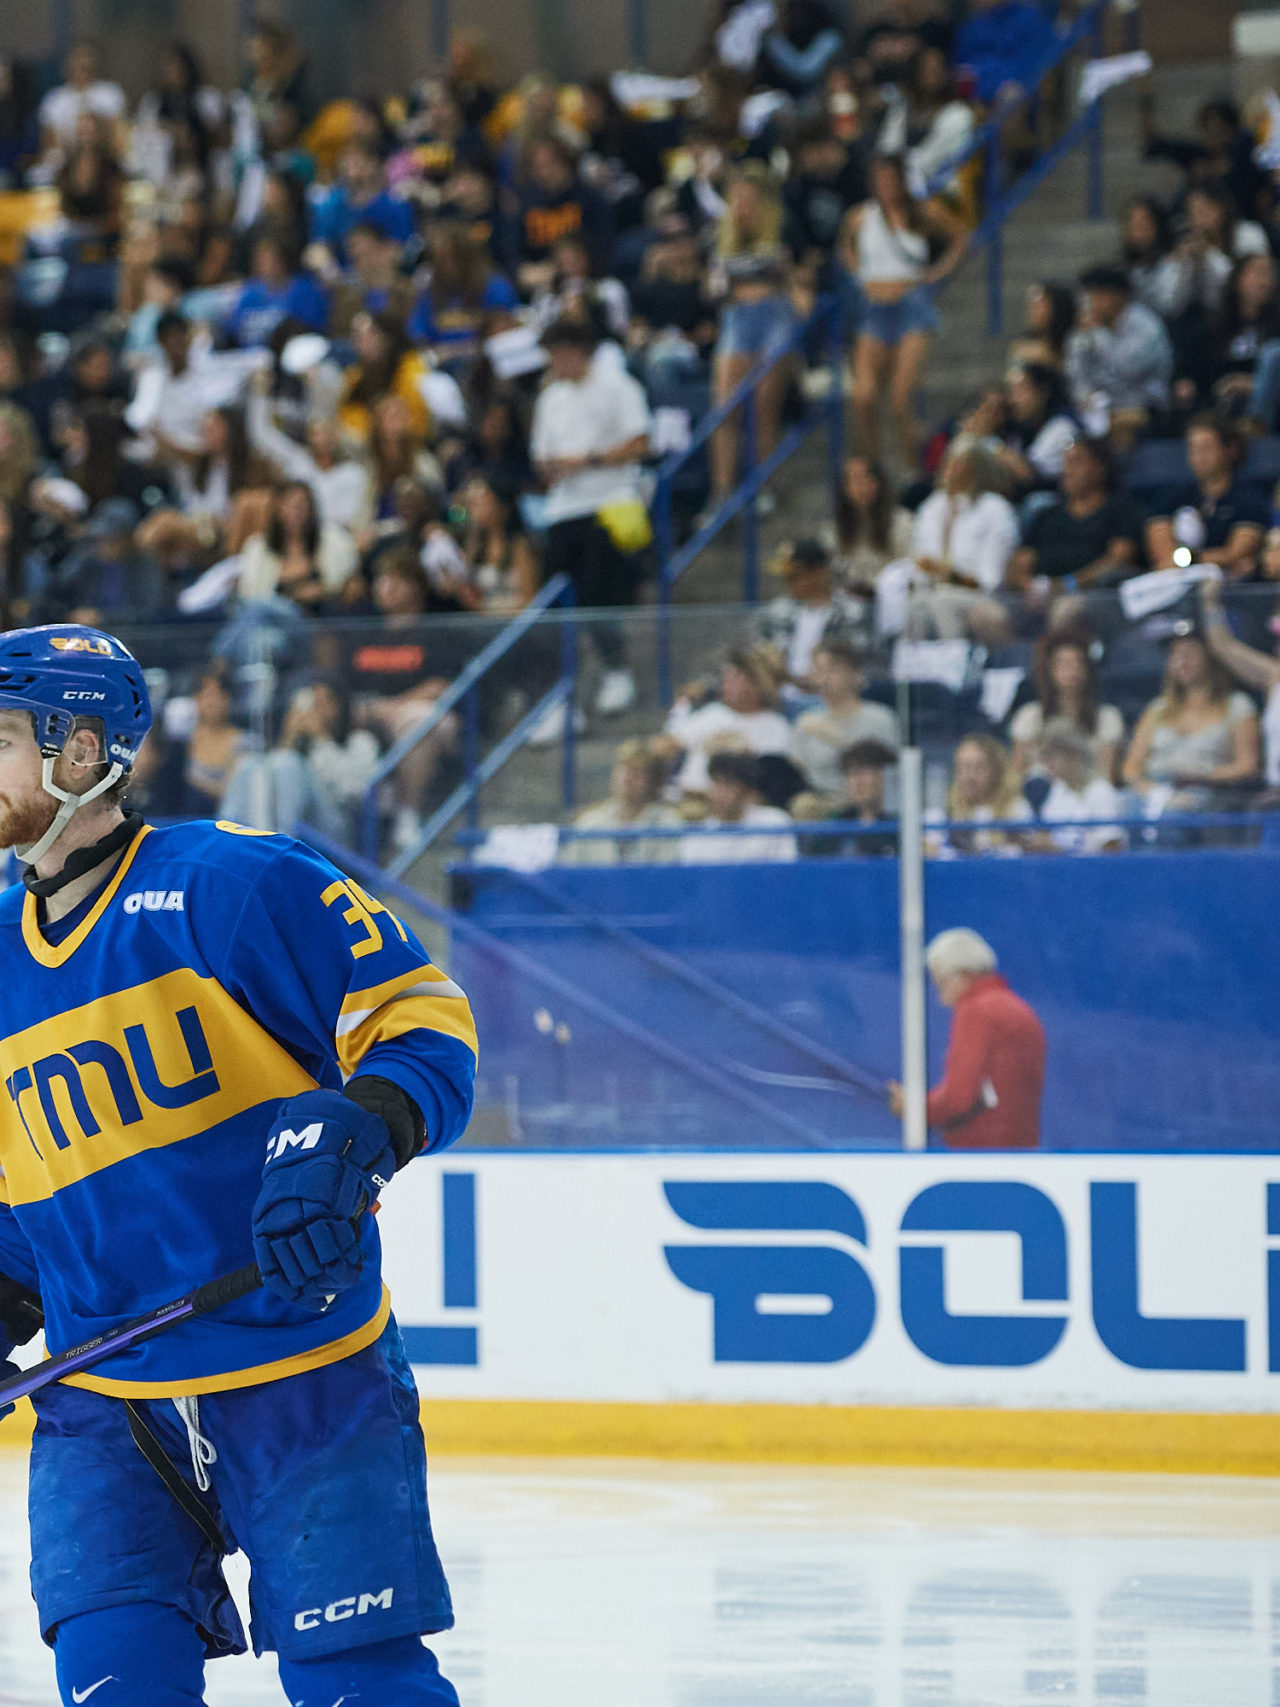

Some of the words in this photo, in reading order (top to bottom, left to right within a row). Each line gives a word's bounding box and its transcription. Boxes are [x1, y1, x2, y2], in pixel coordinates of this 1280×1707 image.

[62, 690, 106, 701] CCM
[123, 890, 185, 915] OUA
[5, 1004, 221, 1161] TMU
[662, 1179, 1280, 1373] BOL
[65, 1336, 103, 1360] TRIGGER
[294, 1587, 394, 1632] CCM
